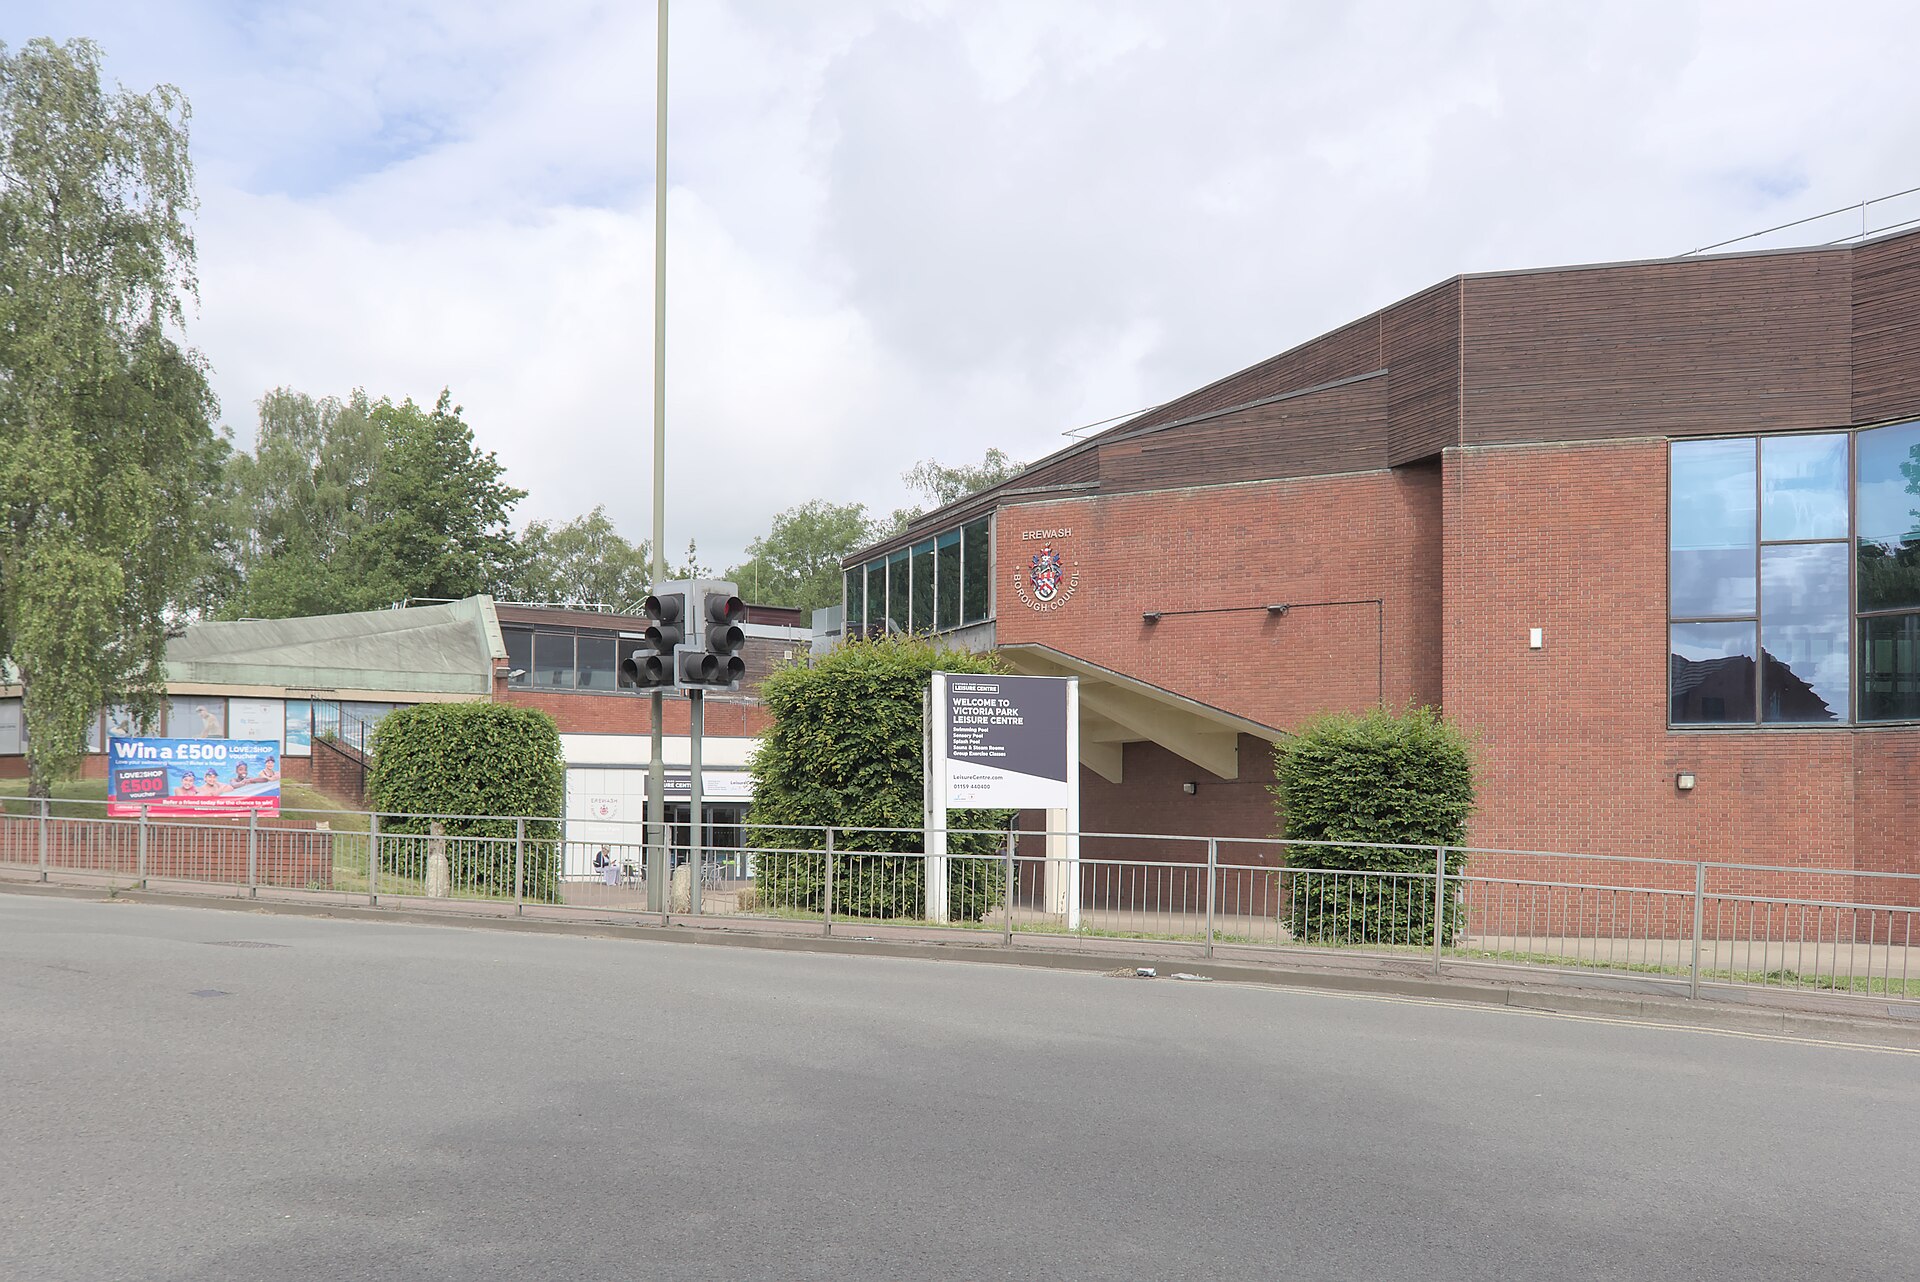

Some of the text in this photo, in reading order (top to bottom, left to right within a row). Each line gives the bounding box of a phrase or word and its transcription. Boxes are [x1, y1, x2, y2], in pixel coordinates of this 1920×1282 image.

[1022, 527, 1072, 540] EREWASH
[1013, 570, 1080, 612] BOROUGH COUNCIL
[952, 698, 1010, 707] WELCOME TO
[952, 707, 1019, 716] VICTORIA PARK
[953, 716, 1024, 725] LEISURE CENTRE
[114, 742, 155, 759] Win
[160, 747, 172, 759] a
[176, 744, 227, 760] £500
[119, 770, 163, 779] LOVE2SHOP
[120, 778, 163, 793] £500
[129, 791, 156, 799] voucher
